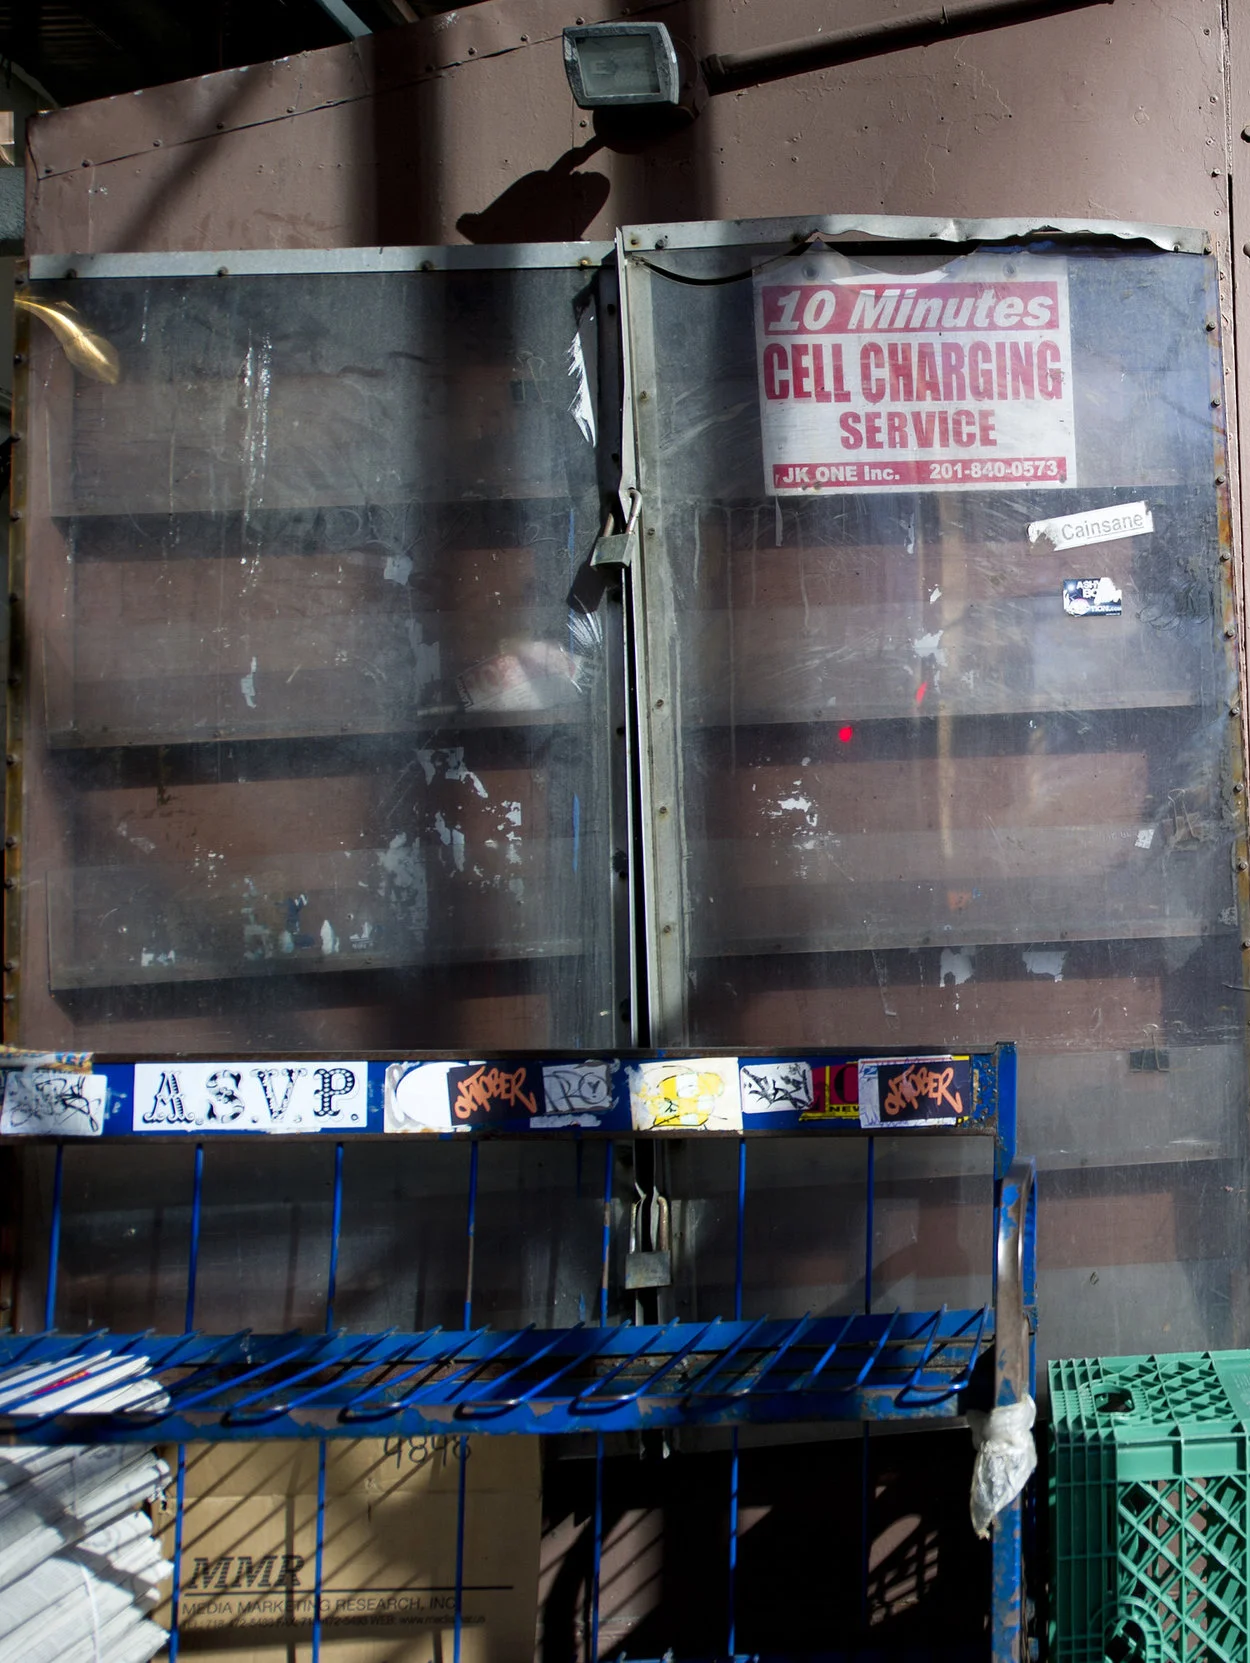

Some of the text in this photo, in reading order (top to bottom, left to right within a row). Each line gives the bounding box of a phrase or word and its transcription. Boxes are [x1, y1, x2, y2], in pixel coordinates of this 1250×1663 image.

[769, 289, 1054, 332] 10 Minutes
[764, 340, 1063, 404] CELL CHARGING
[839, 409, 997, 450] SERVICE
[783, 460, 1058, 484] JK ONE Inc. 201-840-0573
[1061, 513, 1143, 540] Cainsane
[187, 1555, 305, 1589] MMR
[181, 1602, 233, 1616] MEDIA
[335, 1597, 424, 1612] RESEARCH,
